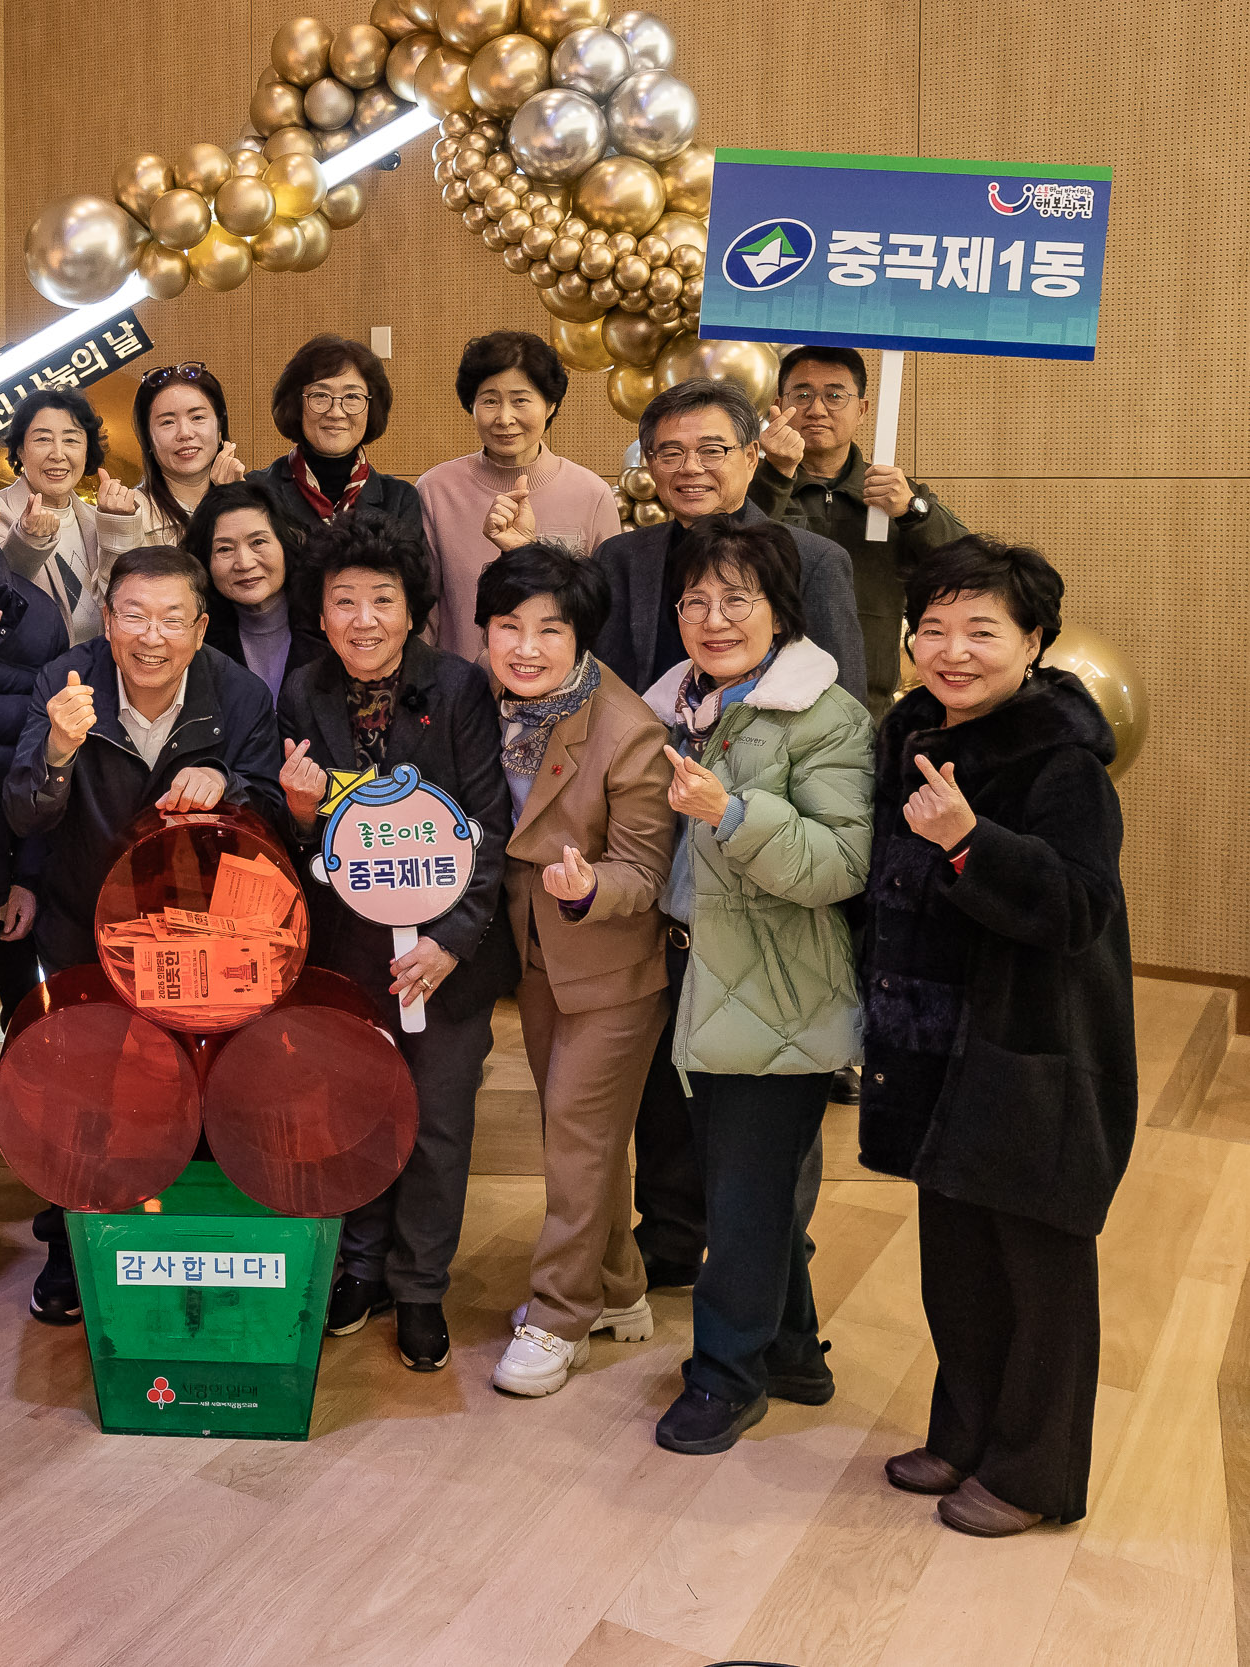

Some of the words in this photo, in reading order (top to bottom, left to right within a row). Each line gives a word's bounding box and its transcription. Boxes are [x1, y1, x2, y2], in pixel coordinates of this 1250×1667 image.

[1035, 196, 1091, 217] 행복광진
[827, 229, 1085, 298] 중곡제1동
[102, 320, 143, 359] 날
[349, 856, 457, 891] 중곡제1동
[165, 950, 180, 999] 따뜻한
[121, 1255, 279, 1281] 감사합니다!
